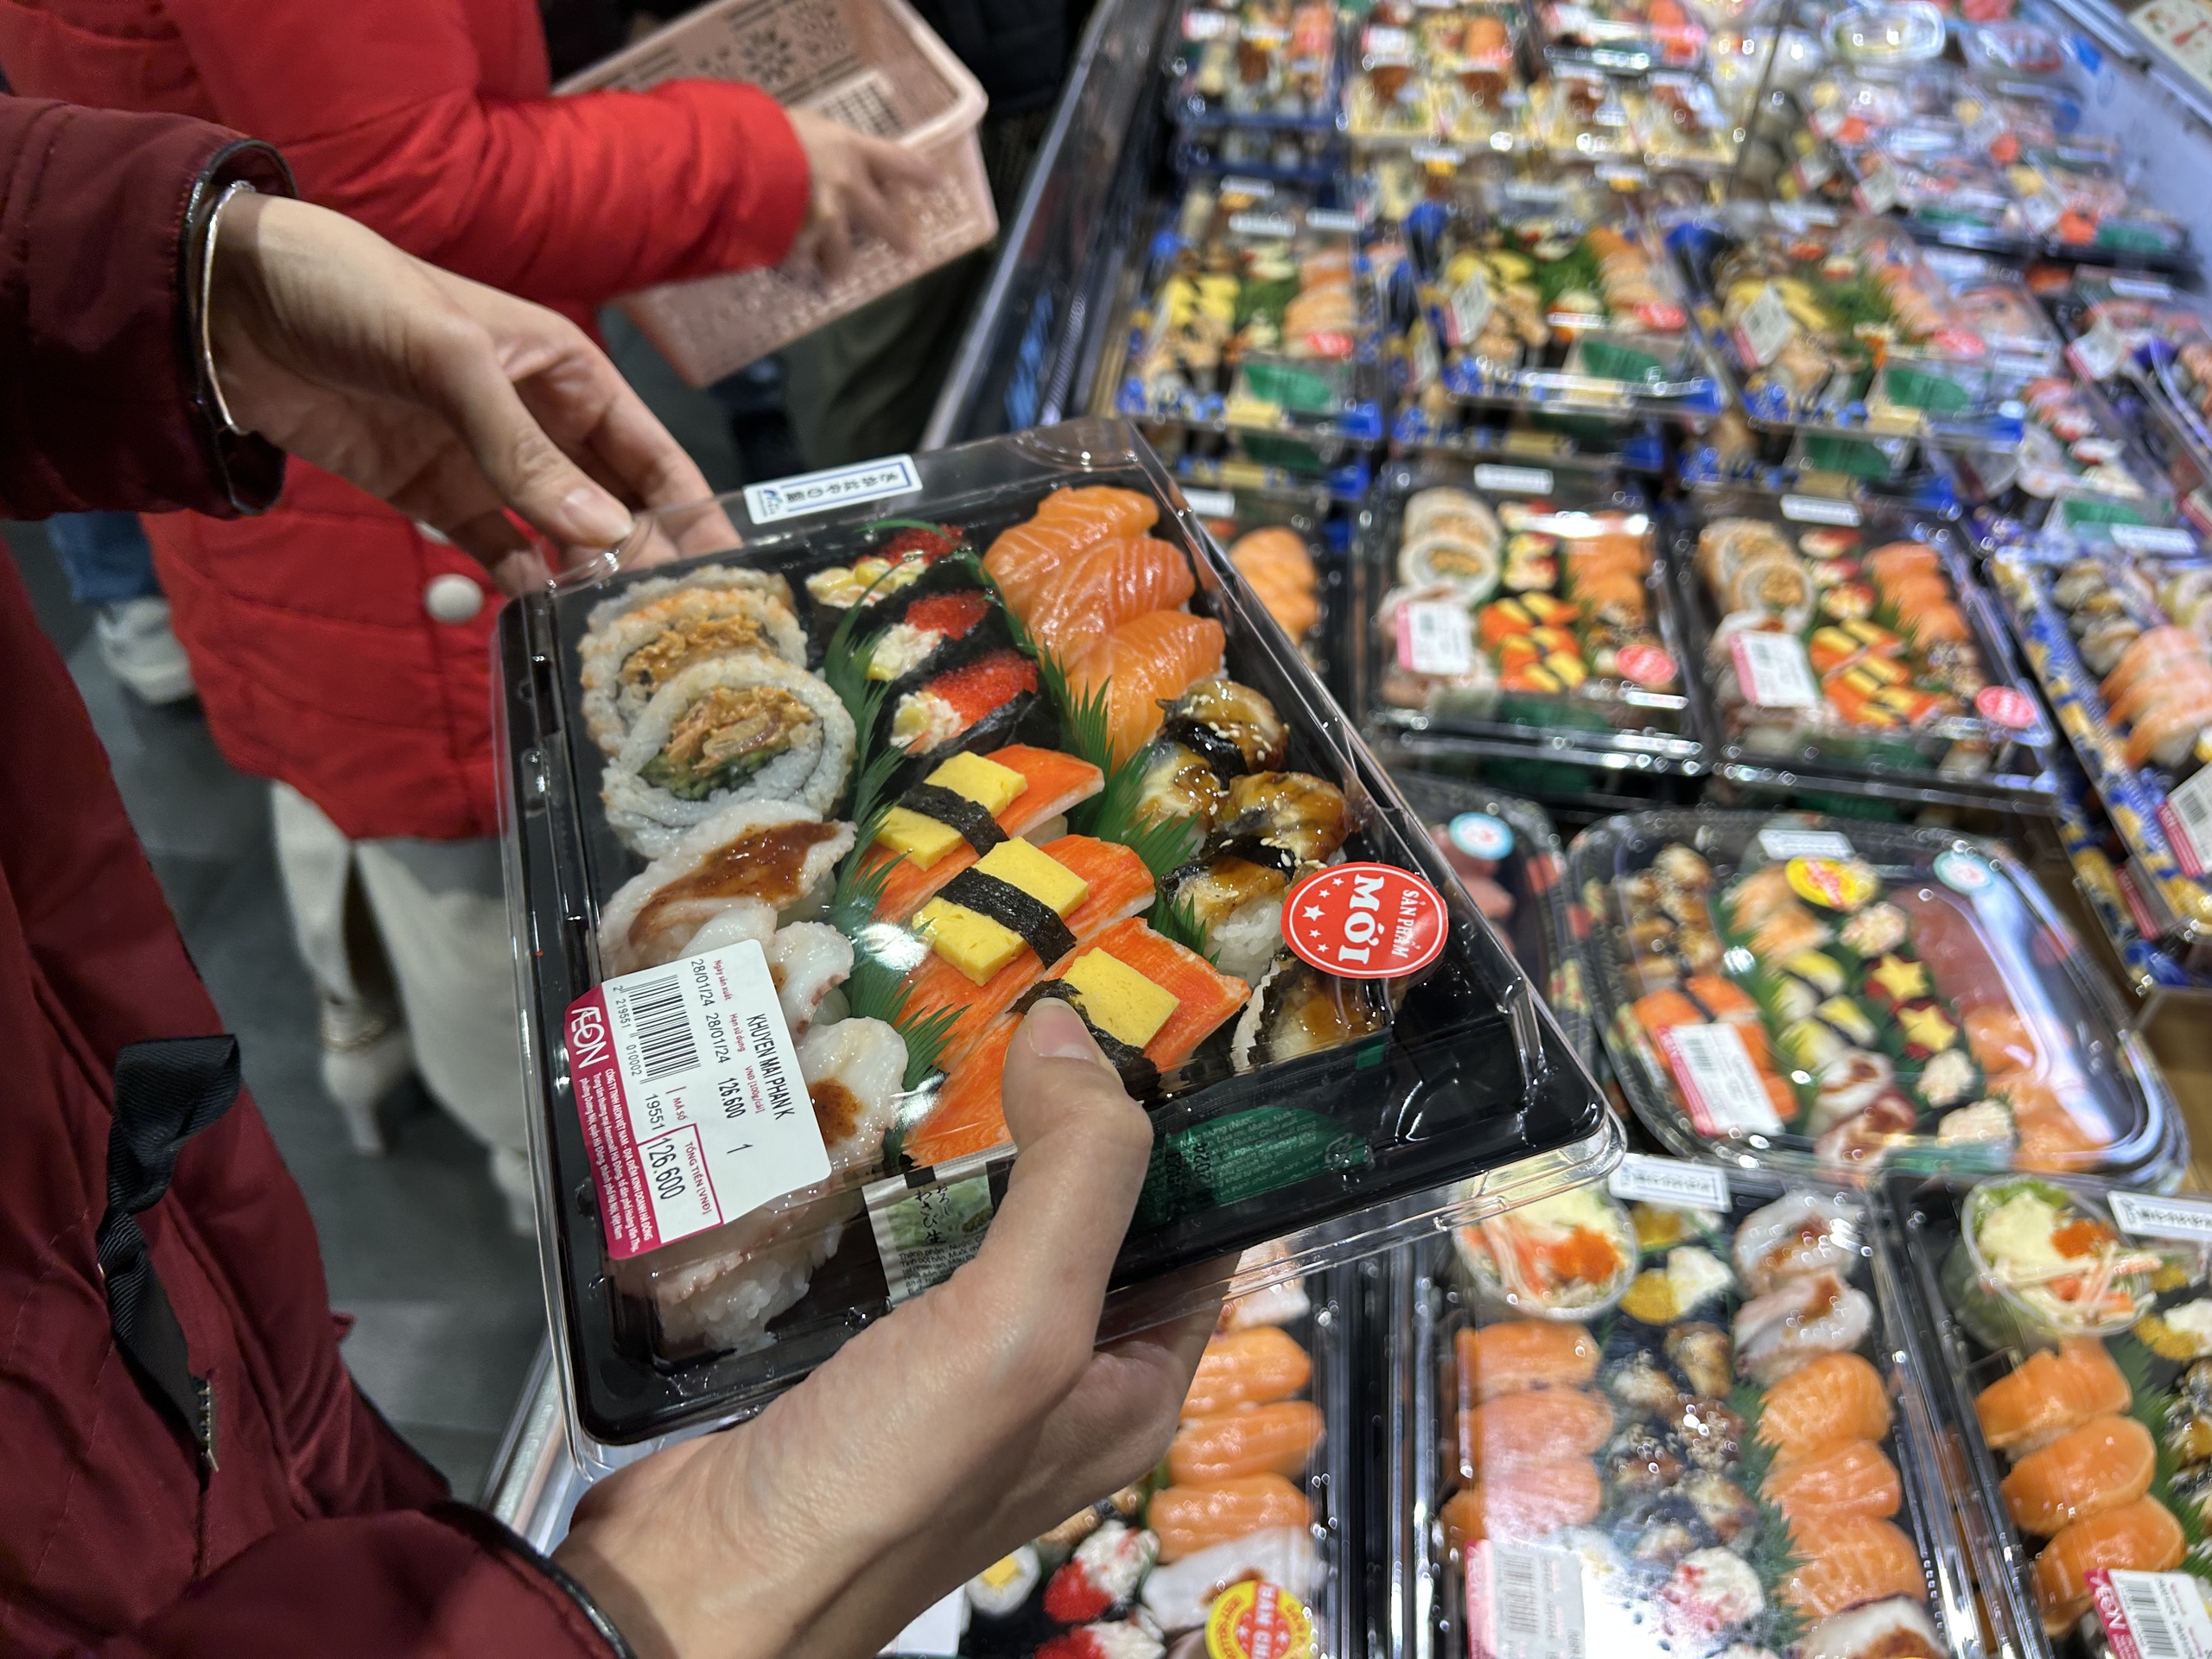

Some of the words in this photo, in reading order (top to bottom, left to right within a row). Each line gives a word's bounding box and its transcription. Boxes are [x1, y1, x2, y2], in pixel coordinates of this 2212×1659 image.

[1399, 889, 1426, 917] SẢN
[1338, 874, 1384, 964] MỚI
[1391, 918, 1421, 959] PHẨM
[712, 959, 725, 976] Ngày
[690, 957, 715, 1007] 28/01/24
[718, 974, 728, 986] sản
[721, 985, 733, 1001] xuất
[728, 1013, 740, 1027] Hạn
[615, 997, 632, 1029] 219551
[625, 1043, 642, 1077] 010002
[704, 1011, 731, 1064] 28/01/24
[733, 1025, 743, 1035] sử
[746, 1012, 777, 1058] KHUYEN
[734, 1033, 747, 1052] dụng
[604, 1066, 617, 1084] CÔNG
[743, 1065, 755, 1081] VNĐ
[759, 1055, 783, 1079] MAI
[590, 1071, 603, 1089] Trung
[607, 1082, 618, 1092] TY
[608, 1089, 620, 1105] TNHH
[716, 1076, 747, 1120] 126.600
[765, 1075, 792, 1109] PHAN
[611, 1103, 624, 1121] AEON
[644, 1092, 665, 1131] 19551
[672, 1096, 684, 1110] MÃ
[676, 1109, 689, 1122] SỐ
[773, 1106, 795, 1121] K
[613, 1117, 627, 1132] VIỆT
[617, 1128, 629, 1147] NAM
[620, 1147, 633, 1161] ĐỊA
[683, 1140, 700, 1166] TỔNG
[726, 1141, 753, 1156] 1
[626, 1157, 640, 1178] ĐIỂM
[645, 1134, 686, 1203] 126.600
[690, 1164, 706, 1187] TIỀN
[630, 1175, 643, 1193] KINH
[633, 1190, 647, 1215] DOANH
[696, 1185, 712, 1215] [VNĐ]
[936, 1185, 950, 1217] おろし
[639, 1211, 651, 1223] HÀ
